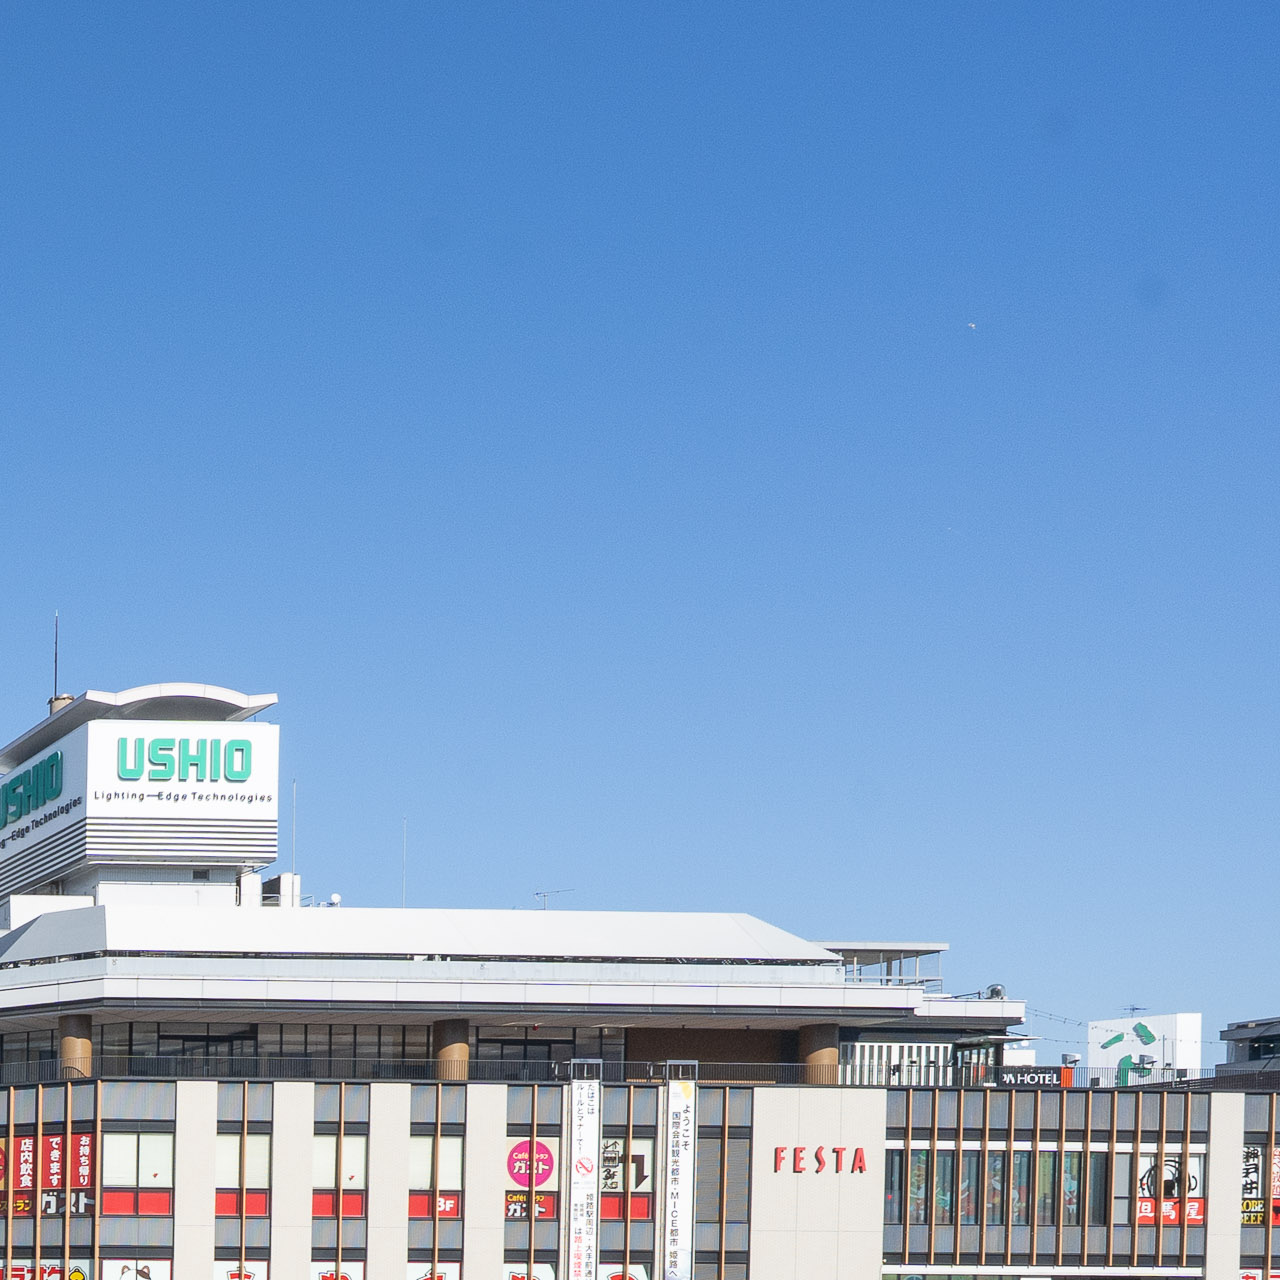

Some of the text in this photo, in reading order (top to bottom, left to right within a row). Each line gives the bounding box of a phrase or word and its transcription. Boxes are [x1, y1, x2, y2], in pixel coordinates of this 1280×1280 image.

[117, 737, 252, 782] USHIO
[30, 796, 83, 831] Technologies
[190, 791, 273, 803] Technologies
[1017, 1073, 1061, 1085] HOTEL
[681, 1104, 691, 1151] ようこそ
[19, 1138, 33, 1187] 店内飲食
[49, 1136, 62, 1187] できます
[78, 1135, 91, 1186] お持ち帰り
[773, 1146, 868, 1174] FESTA
[41, 1191, 96, 1214] ガスト
[1137, 1201, 1204, 1221] 但馬屋
